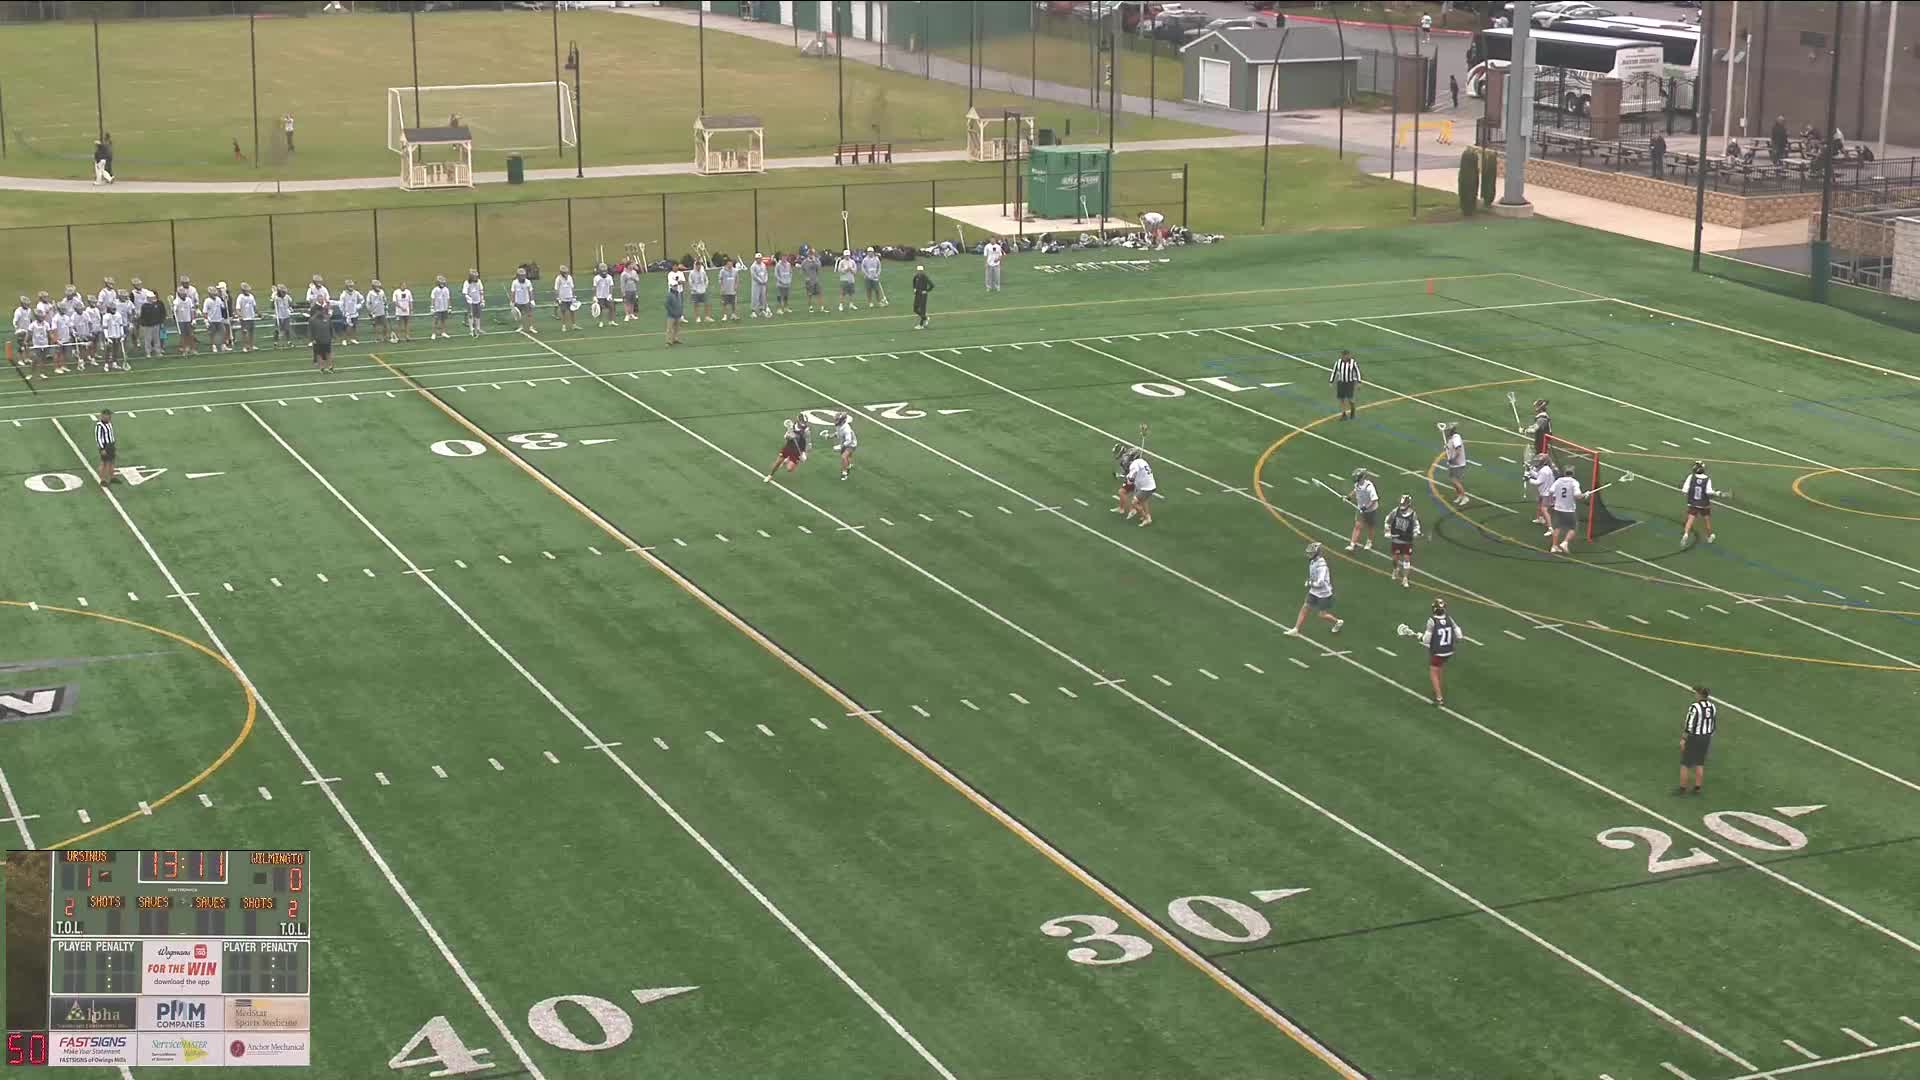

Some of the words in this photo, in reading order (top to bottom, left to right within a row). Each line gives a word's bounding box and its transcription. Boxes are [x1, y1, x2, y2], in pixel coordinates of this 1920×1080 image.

[430, 432, 568, 457] 30
[1561, 487, 1567, 498] 2
[1597, 811, 1808, 873] 20
[1039, 895, 1272, 966] 30
[388, 995, 633, 1078] 40
